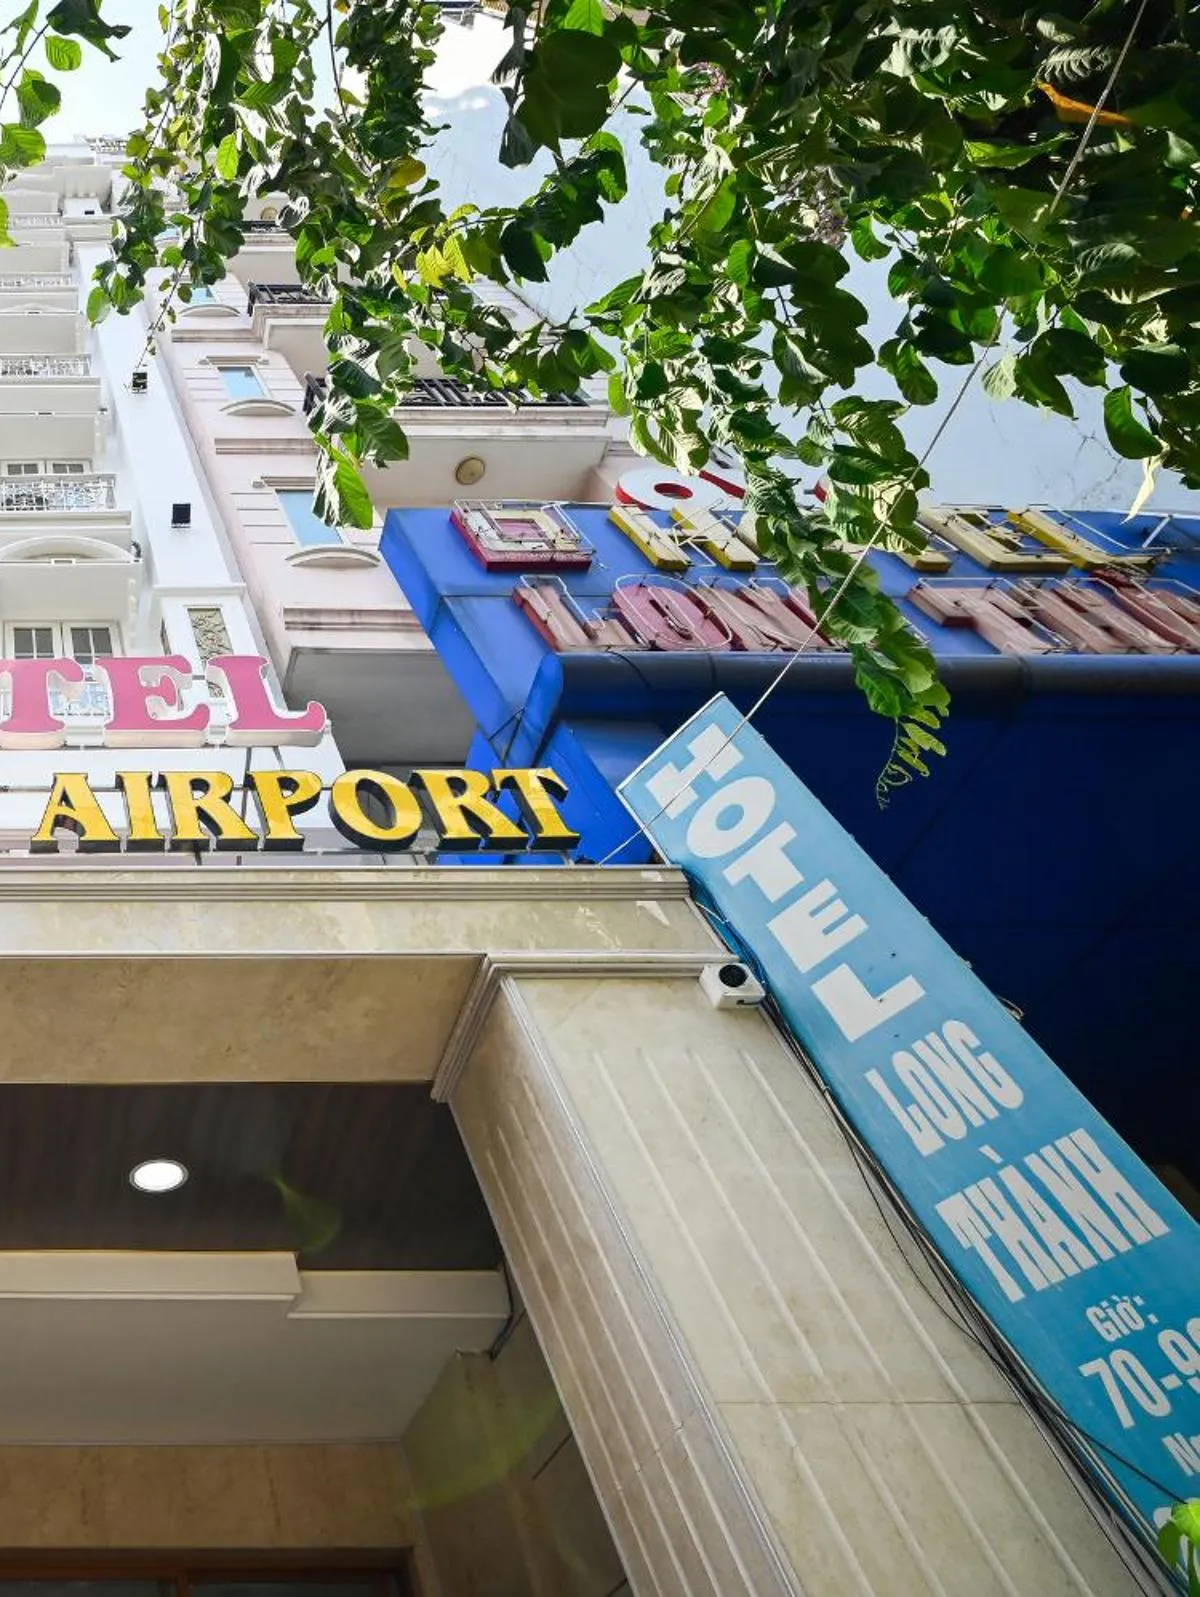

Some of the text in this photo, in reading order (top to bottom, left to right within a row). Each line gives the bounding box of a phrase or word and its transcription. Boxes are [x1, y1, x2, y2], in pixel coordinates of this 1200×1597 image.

[29, 767, 581, 853] AIRPORT
[645, 722, 926, 1044] HOTEL
[865, 1019, 1025, 1157] LONG
[935, 1127, 1170, 1303] THÀNH
